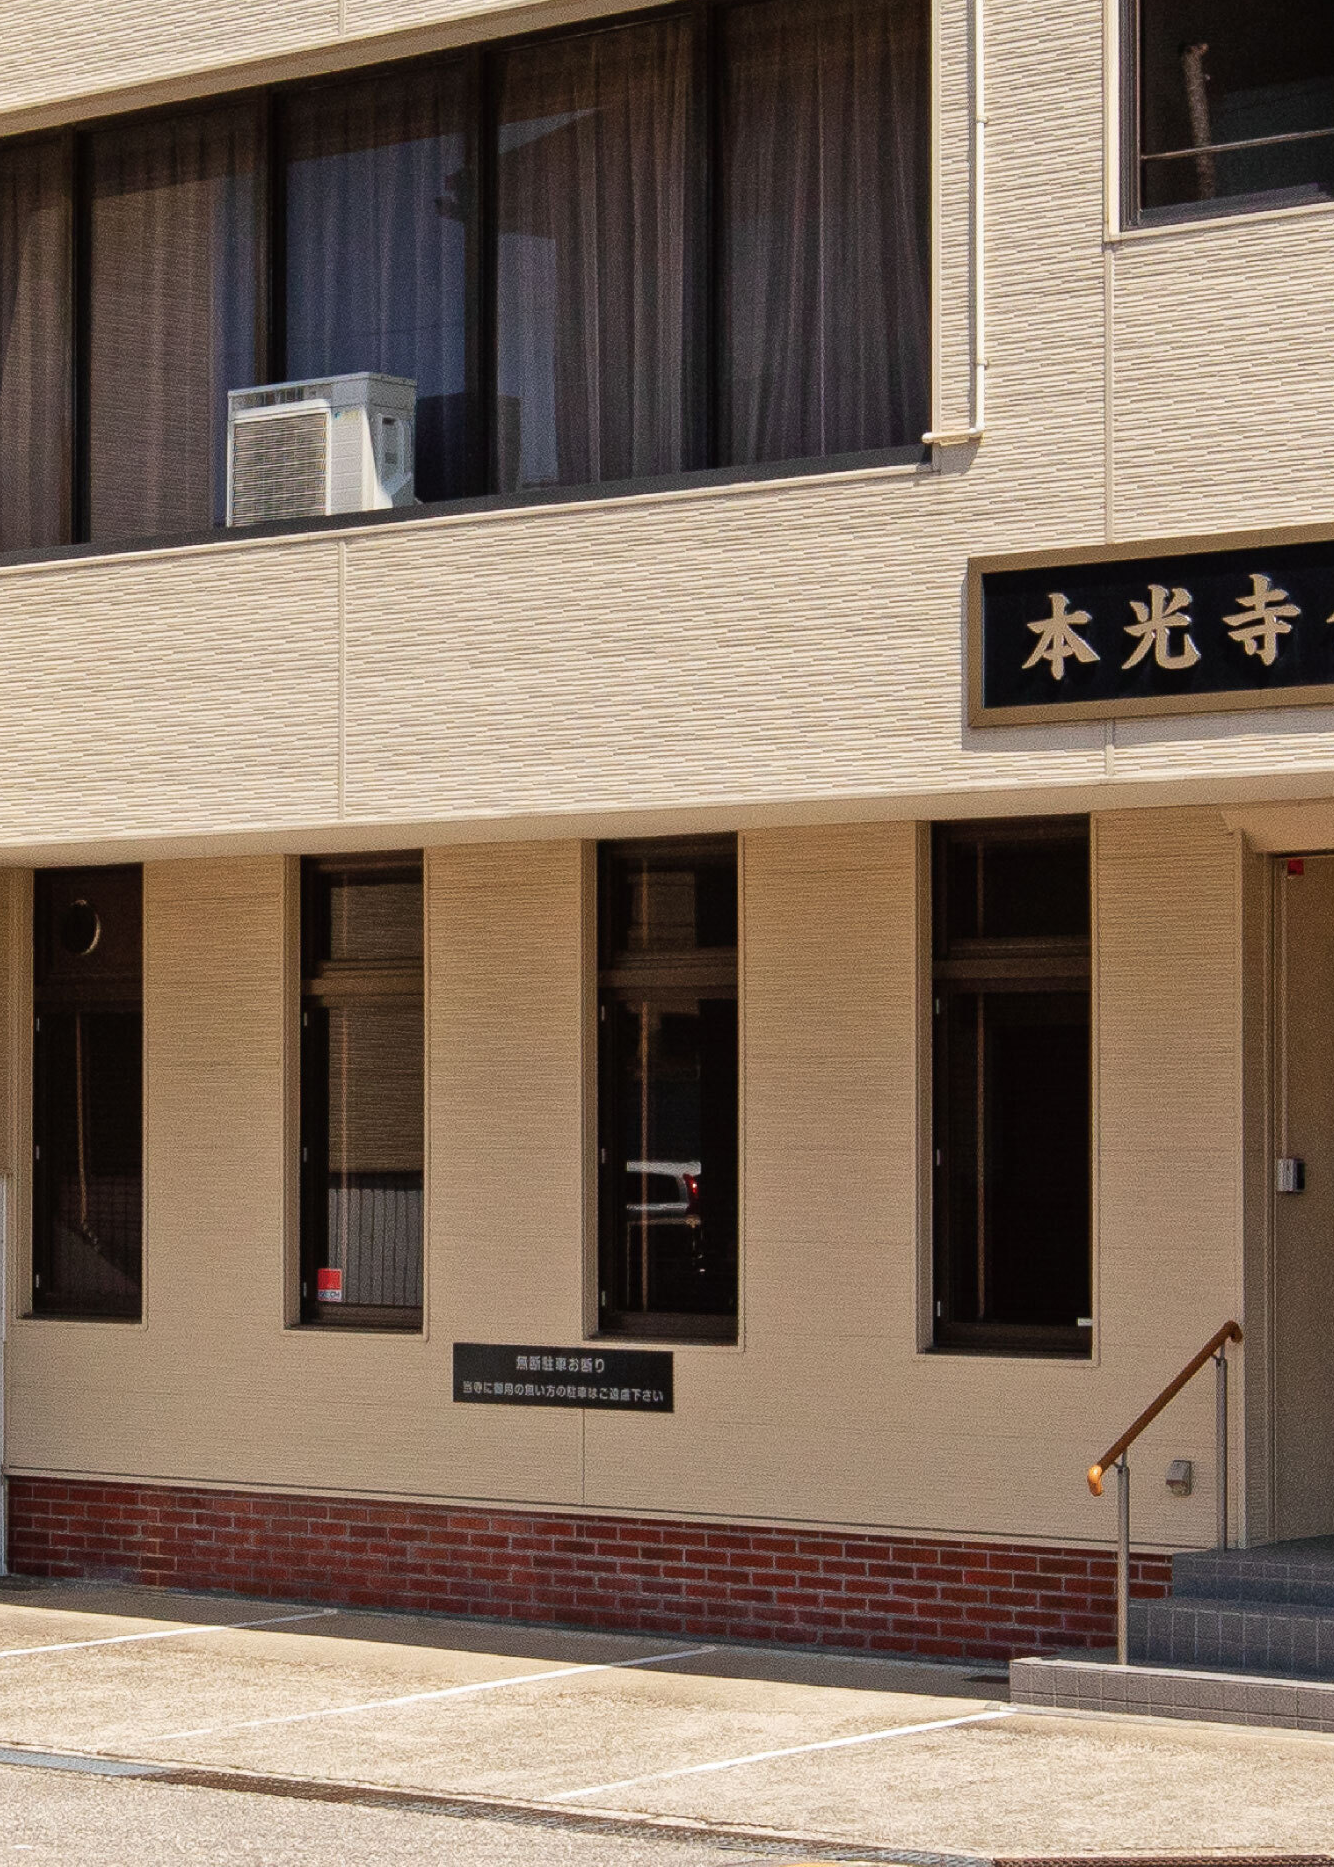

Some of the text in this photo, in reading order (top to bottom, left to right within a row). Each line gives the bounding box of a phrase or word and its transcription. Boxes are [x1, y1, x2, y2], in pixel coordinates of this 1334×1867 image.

[515, 1354, 606, 1374] 無断駐車お断り
